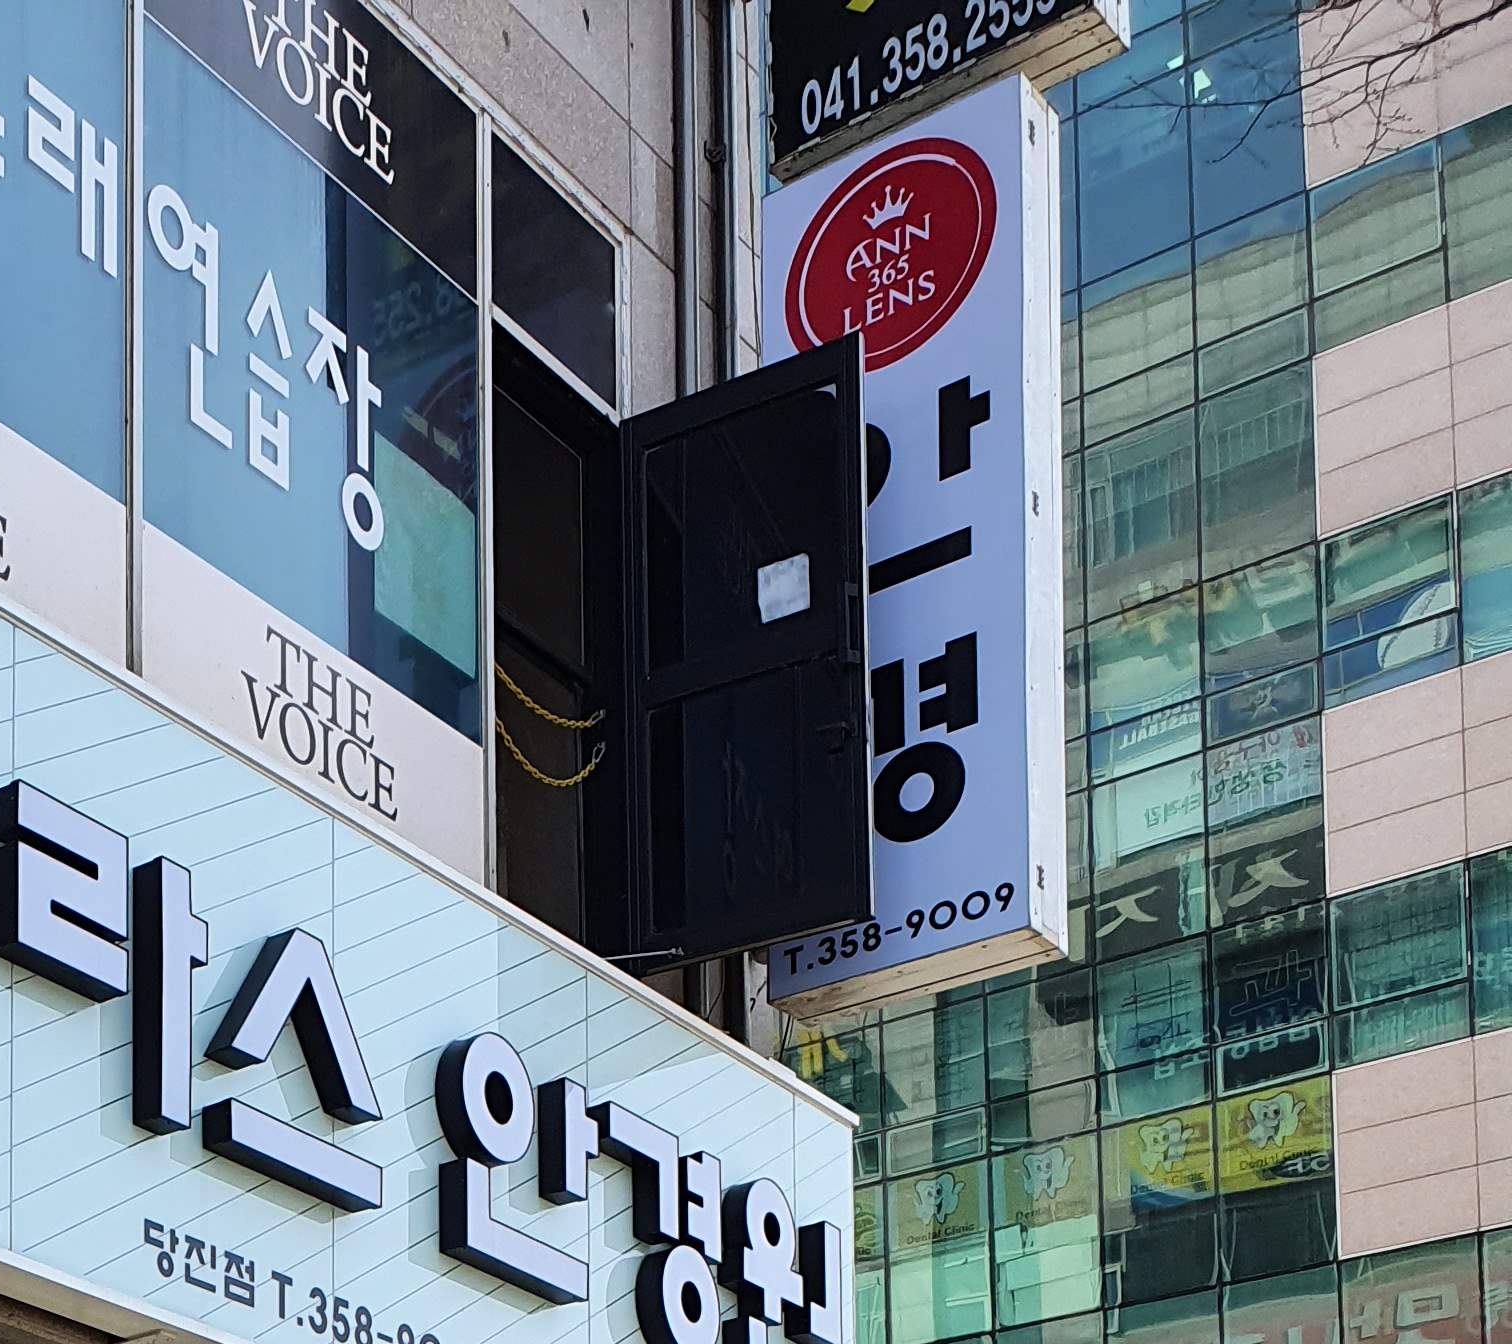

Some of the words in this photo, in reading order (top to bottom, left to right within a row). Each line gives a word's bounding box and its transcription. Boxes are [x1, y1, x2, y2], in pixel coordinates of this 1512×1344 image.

[243, 0, 395, 184] VOICE
[846, 213, 932, 284] ANN
[867, 254, 909, 292] 365
[842, 269, 936, 335] LENS
[266, 624, 375, 751] THE
[240, 669, 398, 823] VOICE
[784, 881, 1015, 976] T.358-9009
[143, 1219, 256, 1308] 당진점
[906, 1228, 941, 1245] Dental
[944, 1221, 975, 1237] Clinic
